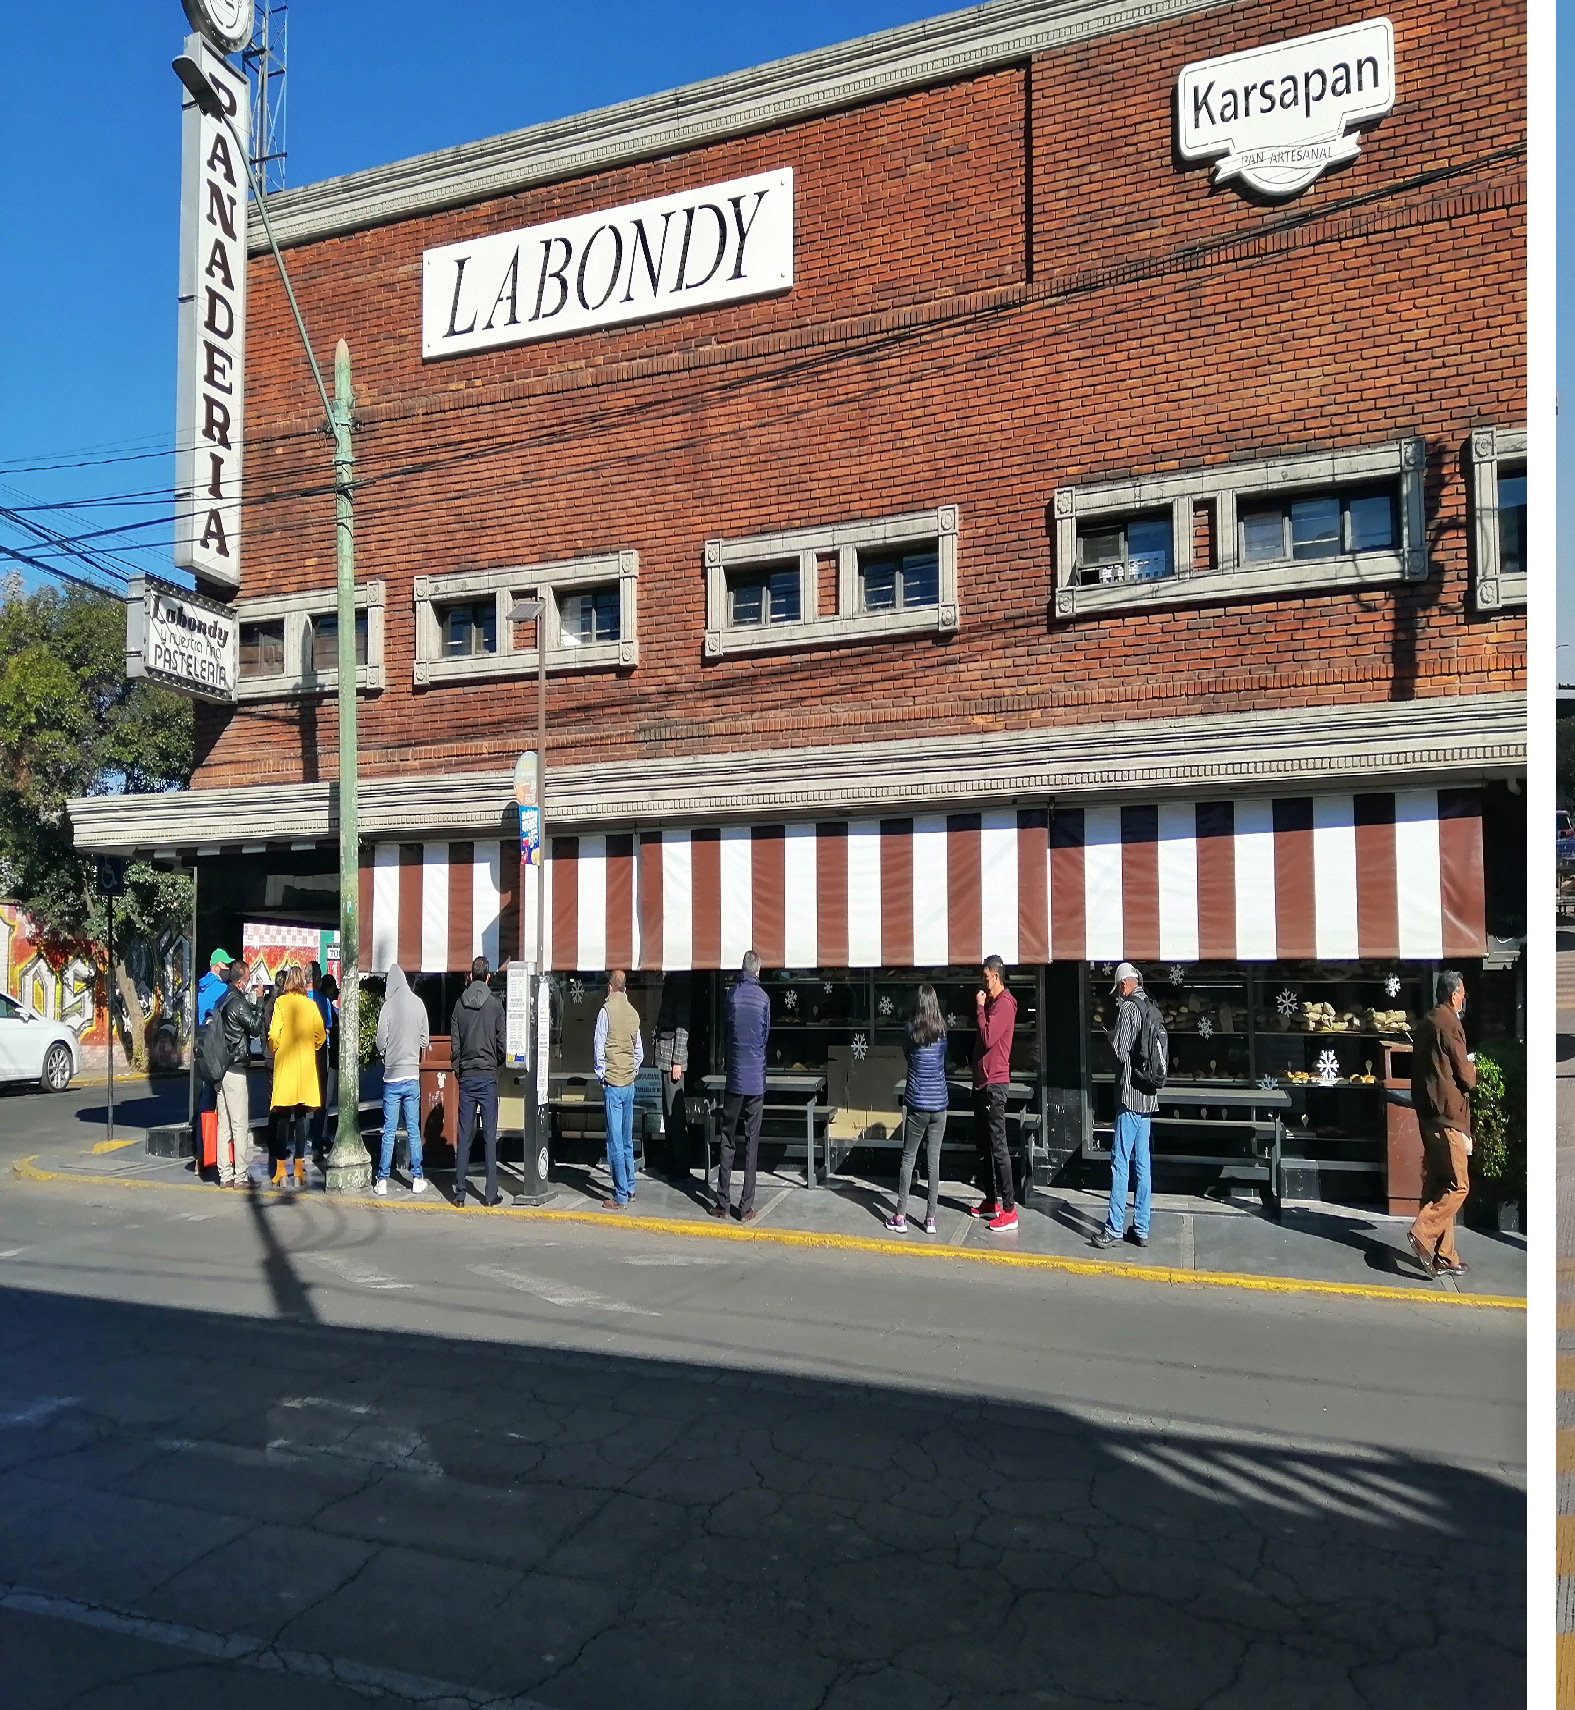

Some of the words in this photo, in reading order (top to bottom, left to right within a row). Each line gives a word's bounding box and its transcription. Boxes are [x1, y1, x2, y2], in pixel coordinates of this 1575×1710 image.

[1193, 55, 1380, 129] Karsapan
[1242, 151, 1264, 165] PAN
[1269, 146, 1333, 165] ARTESANAL
[442, 189, 770, 339] LABONDY
[200, 73, 237, 558] PANADERIA
[151, 594, 229, 648] Labondy
[160, 628, 167, 645] y
[169, 632, 203, 653] nuestra
[155, 644, 226, 685] PASTELERIA
